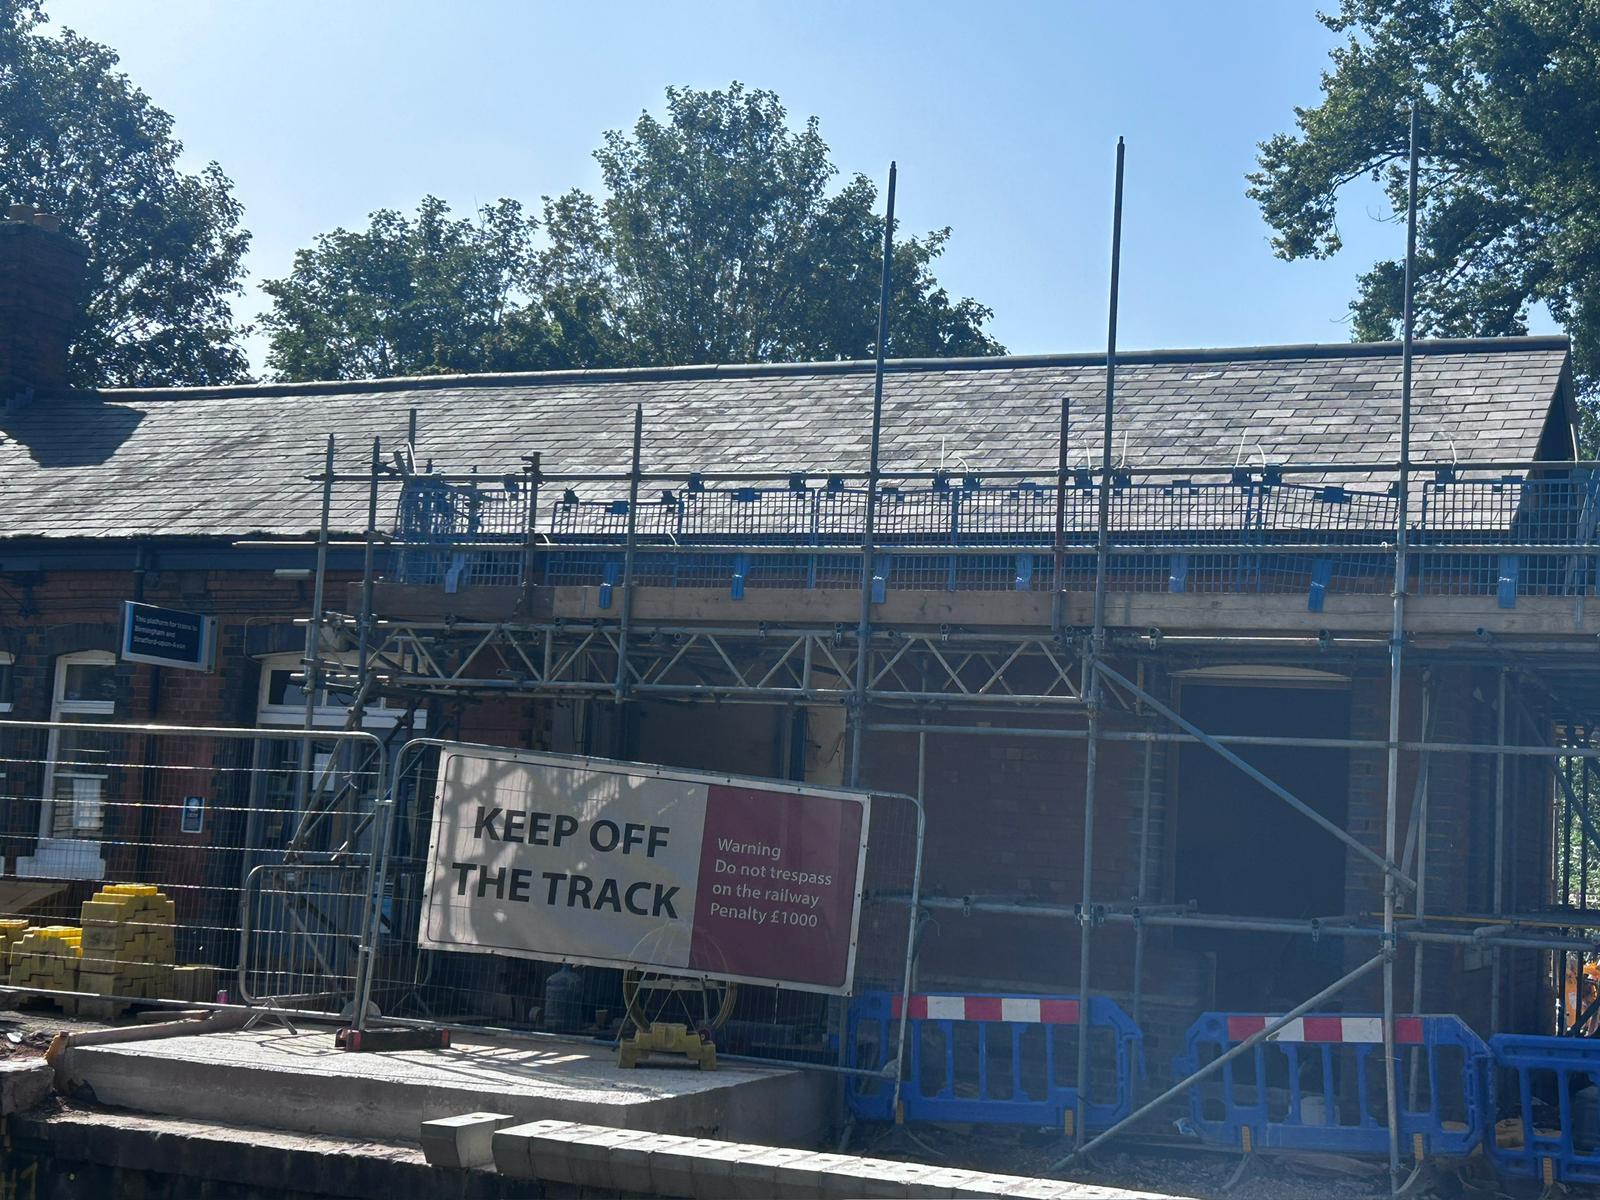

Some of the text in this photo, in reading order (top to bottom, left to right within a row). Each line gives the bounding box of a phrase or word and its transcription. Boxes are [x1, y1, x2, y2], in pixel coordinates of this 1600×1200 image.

[473, 806, 670, 858] KEEP OFF
[718, 837, 782, 861] Warning
[715, 859, 832, 886] Do not trespass
[452, 861, 681, 920] THE TRACK
[712, 884, 819, 909] on the railway
[710, 903, 818, 927] Penalty £1000
